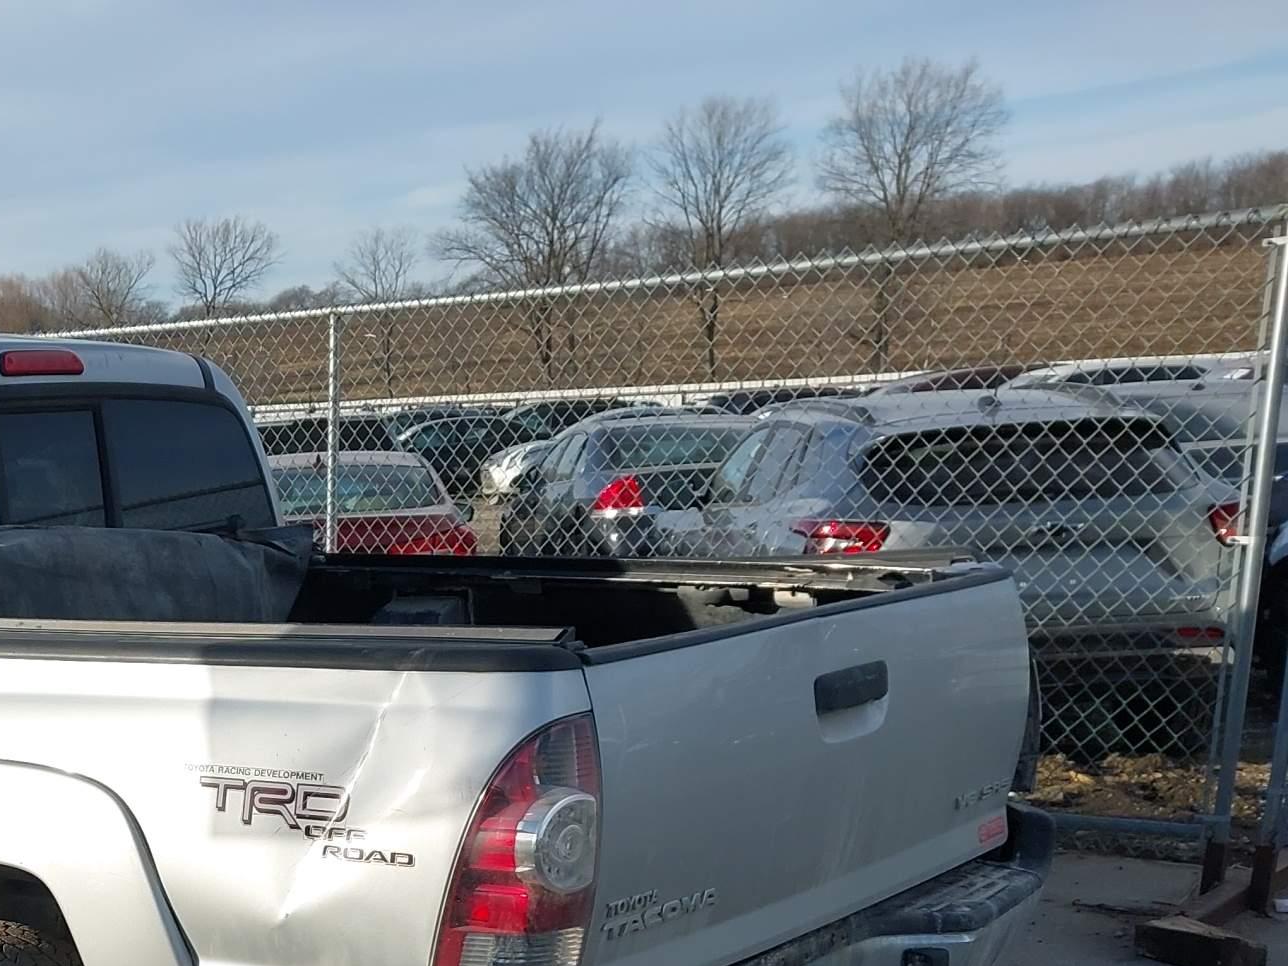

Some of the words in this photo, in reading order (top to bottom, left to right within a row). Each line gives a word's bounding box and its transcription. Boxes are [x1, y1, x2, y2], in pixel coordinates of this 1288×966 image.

[217, 765, 252, 777] RACING
[253, 768, 325, 783] DEVELOPMENT
[200, 775, 351, 830] TRD
[304, 823, 369, 841] OFF
[321, 844, 416, 868] ROAD
[600, 887, 716, 941] TACOMA
